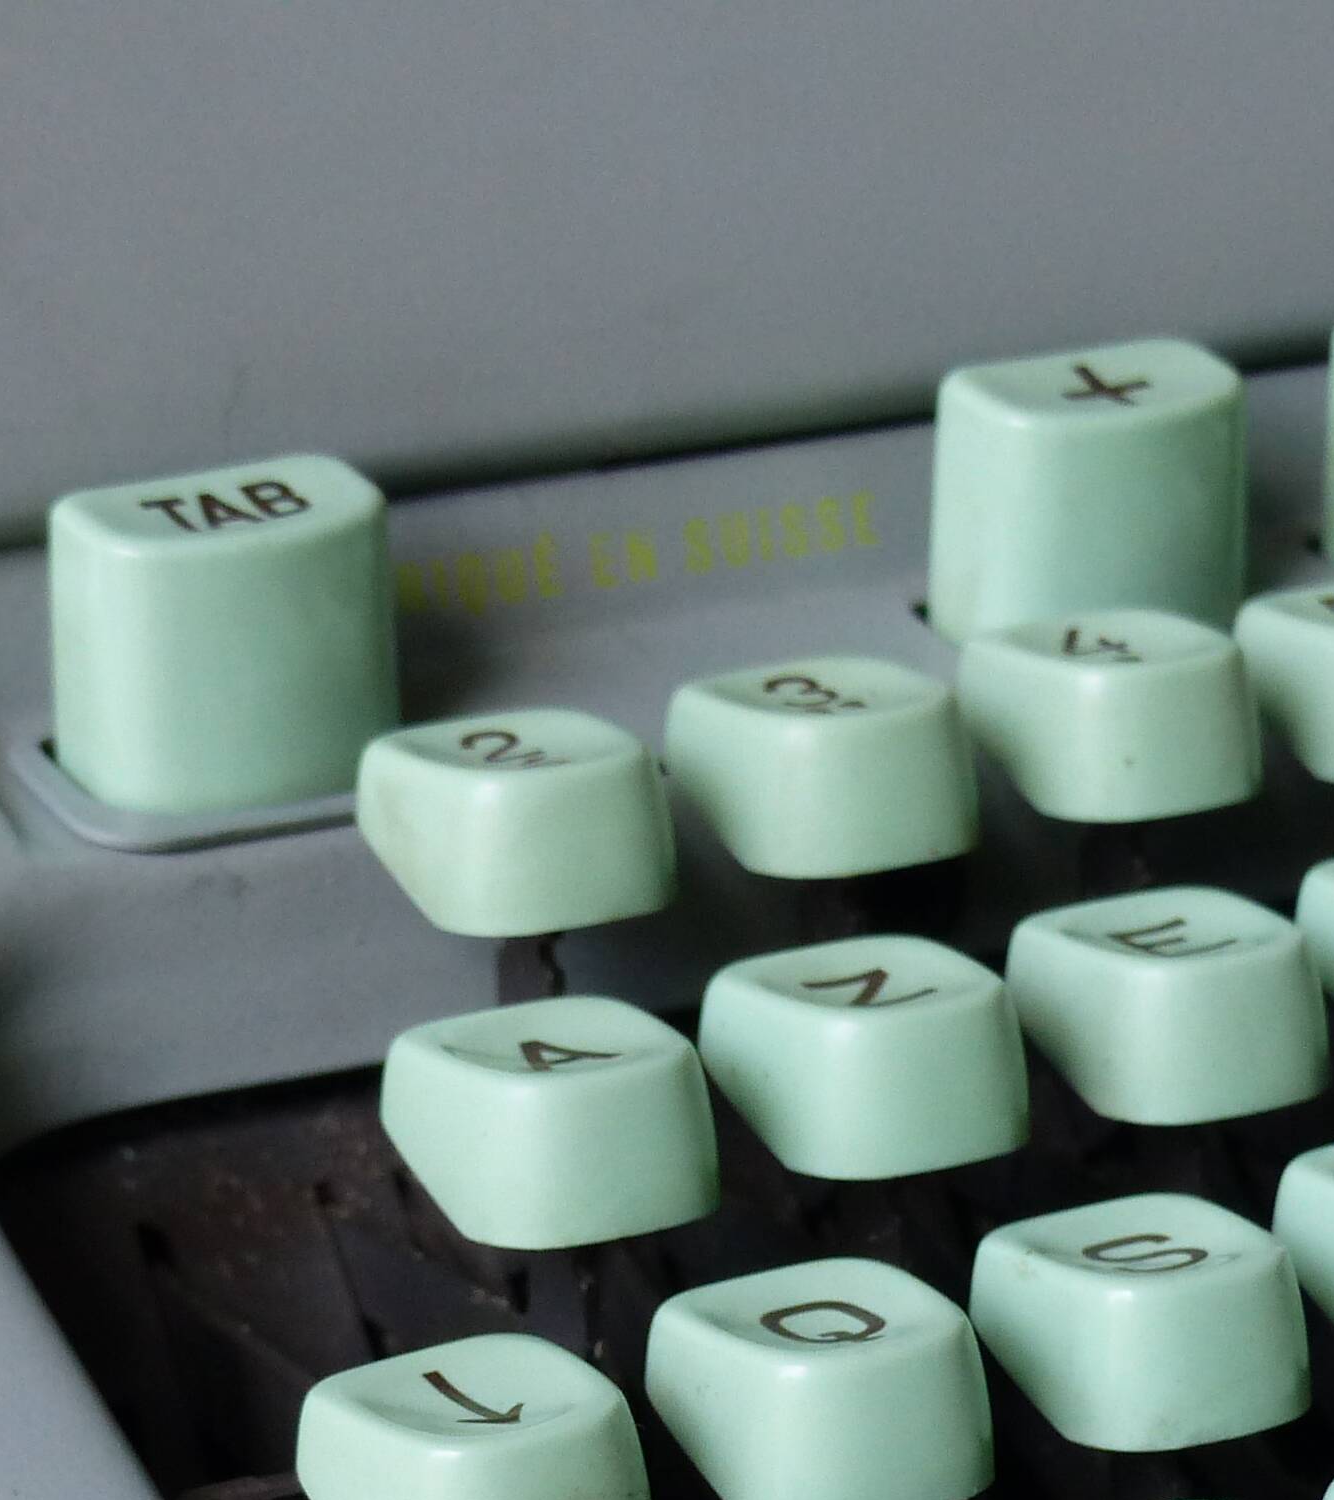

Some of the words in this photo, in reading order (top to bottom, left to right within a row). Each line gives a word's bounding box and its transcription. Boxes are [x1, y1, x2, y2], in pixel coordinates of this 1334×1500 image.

[138, 480, 312, 532] TAB
[589, 528, 659, 590] EN
[682, 491, 882, 575] SUISSE
[1104, 917, 1240, 958] E
[800, 967, 938, 1007] Z
[519, 1039, 623, 1073] A
[1081, 1231, 1210, 1272] S
[759, 1300, 887, 1343] Q
